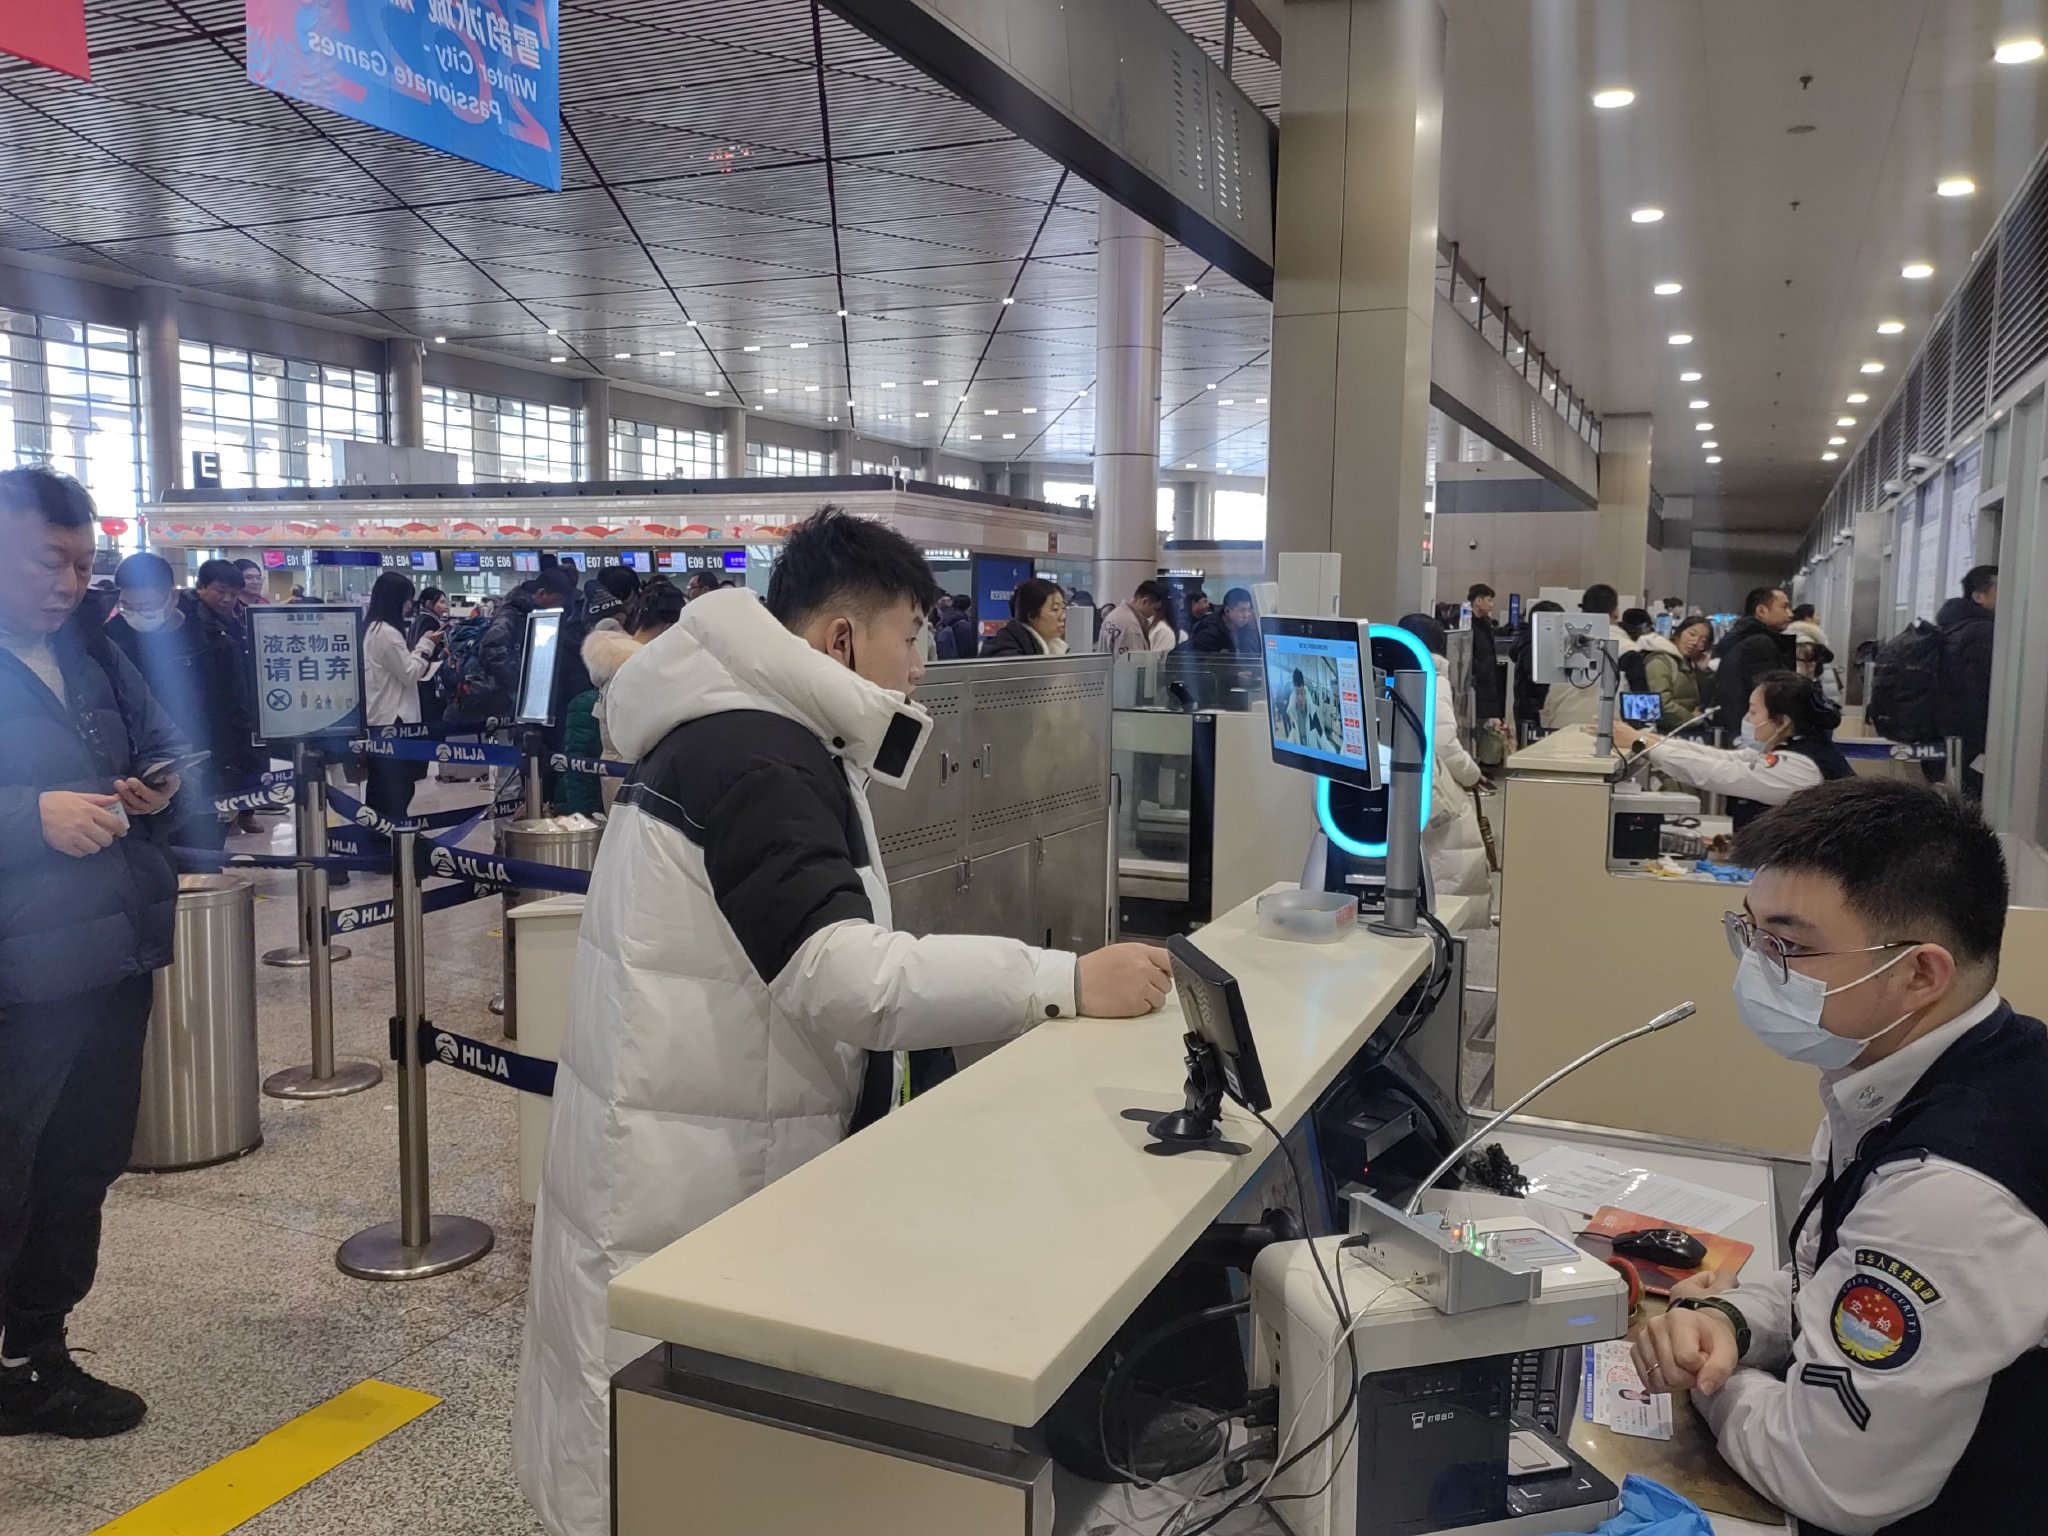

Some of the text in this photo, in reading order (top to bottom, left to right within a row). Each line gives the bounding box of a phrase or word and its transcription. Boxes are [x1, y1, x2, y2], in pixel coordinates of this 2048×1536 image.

[201, 453, 218, 478] E
[286, 555, 299, 566] E01
[396, 555, 410, 567] E04
[480, 556, 494, 568] E05
[497, 556, 511, 568] E06
[586, 556, 600, 568] E07
[687, 556, 704, 569] E09
[706, 556, 723, 569] E10
[263, 634, 350, 653] 液态物品
[264, 656, 352, 682] 请自弃
[400, 725, 428, 738] HLJA
[365, 741, 394, 755] HLJA
[453, 747, 485, 761] HLJA
[1916, 745, 1945, 757] HL
[571, 758, 608, 776] HLJA
[275, 771, 294, 781] HLJ
[214, 791, 268, 812] HLJA
[332, 840, 358, 854] HLJA
[457, 855, 512, 883] HLJA
[462, 1045, 509, 1079] HLJA
[1857, 1252, 1936, 1299] 中华人民共和国
[1850, 1299, 1892, 1332] 安检
